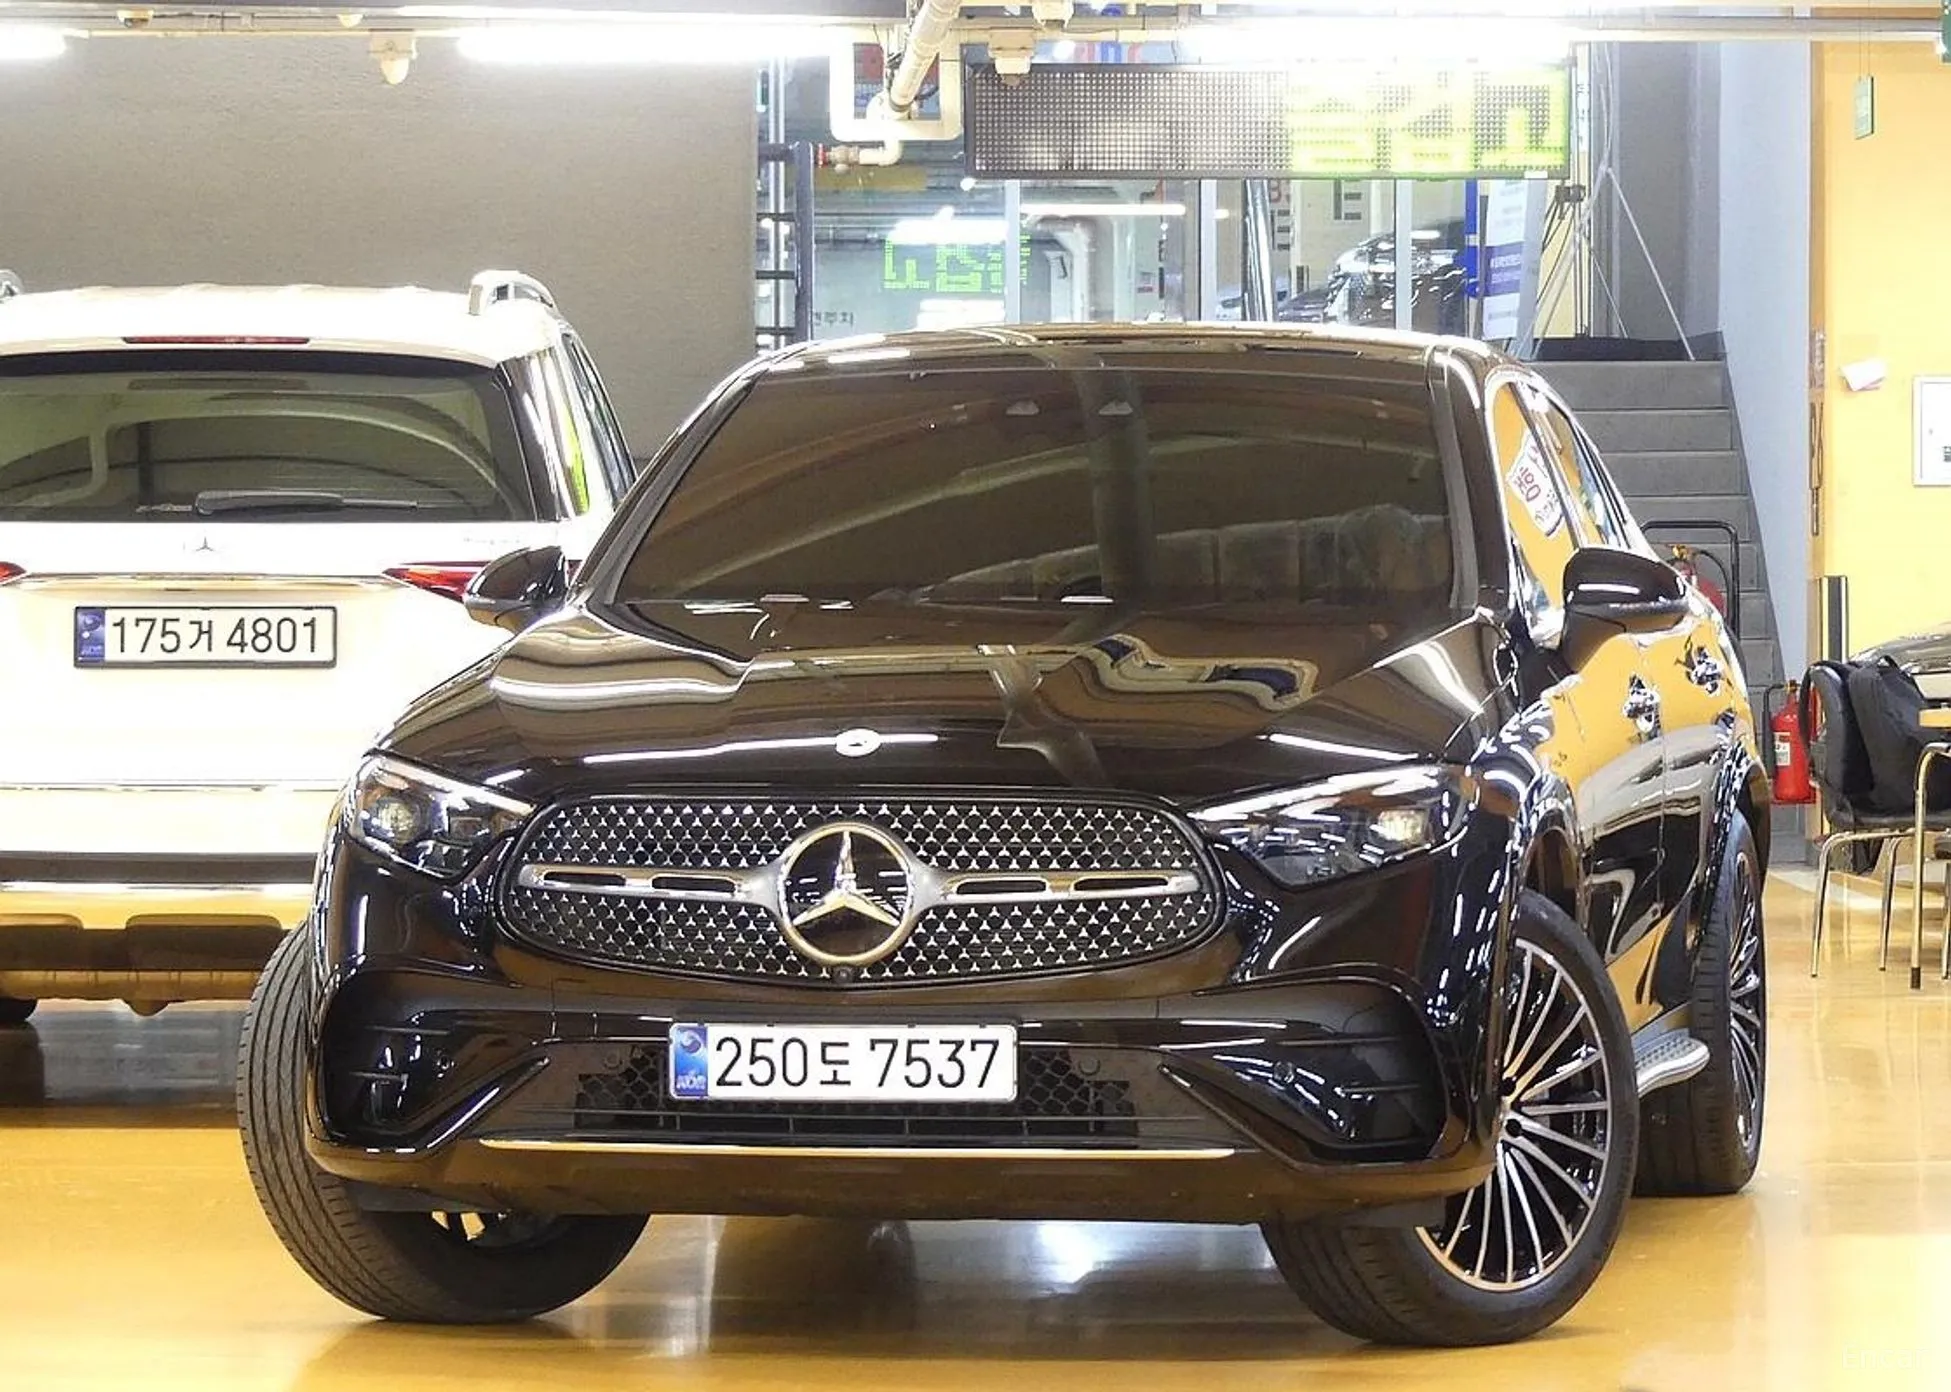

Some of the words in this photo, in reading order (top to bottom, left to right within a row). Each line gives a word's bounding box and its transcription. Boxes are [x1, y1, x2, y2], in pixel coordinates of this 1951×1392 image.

[112, 616, 213, 654] 175거
[226, 616, 317, 654] 4801
[715, 1036, 851, 1088] 250도
[869, 1037, 1000, 1089] 7537
